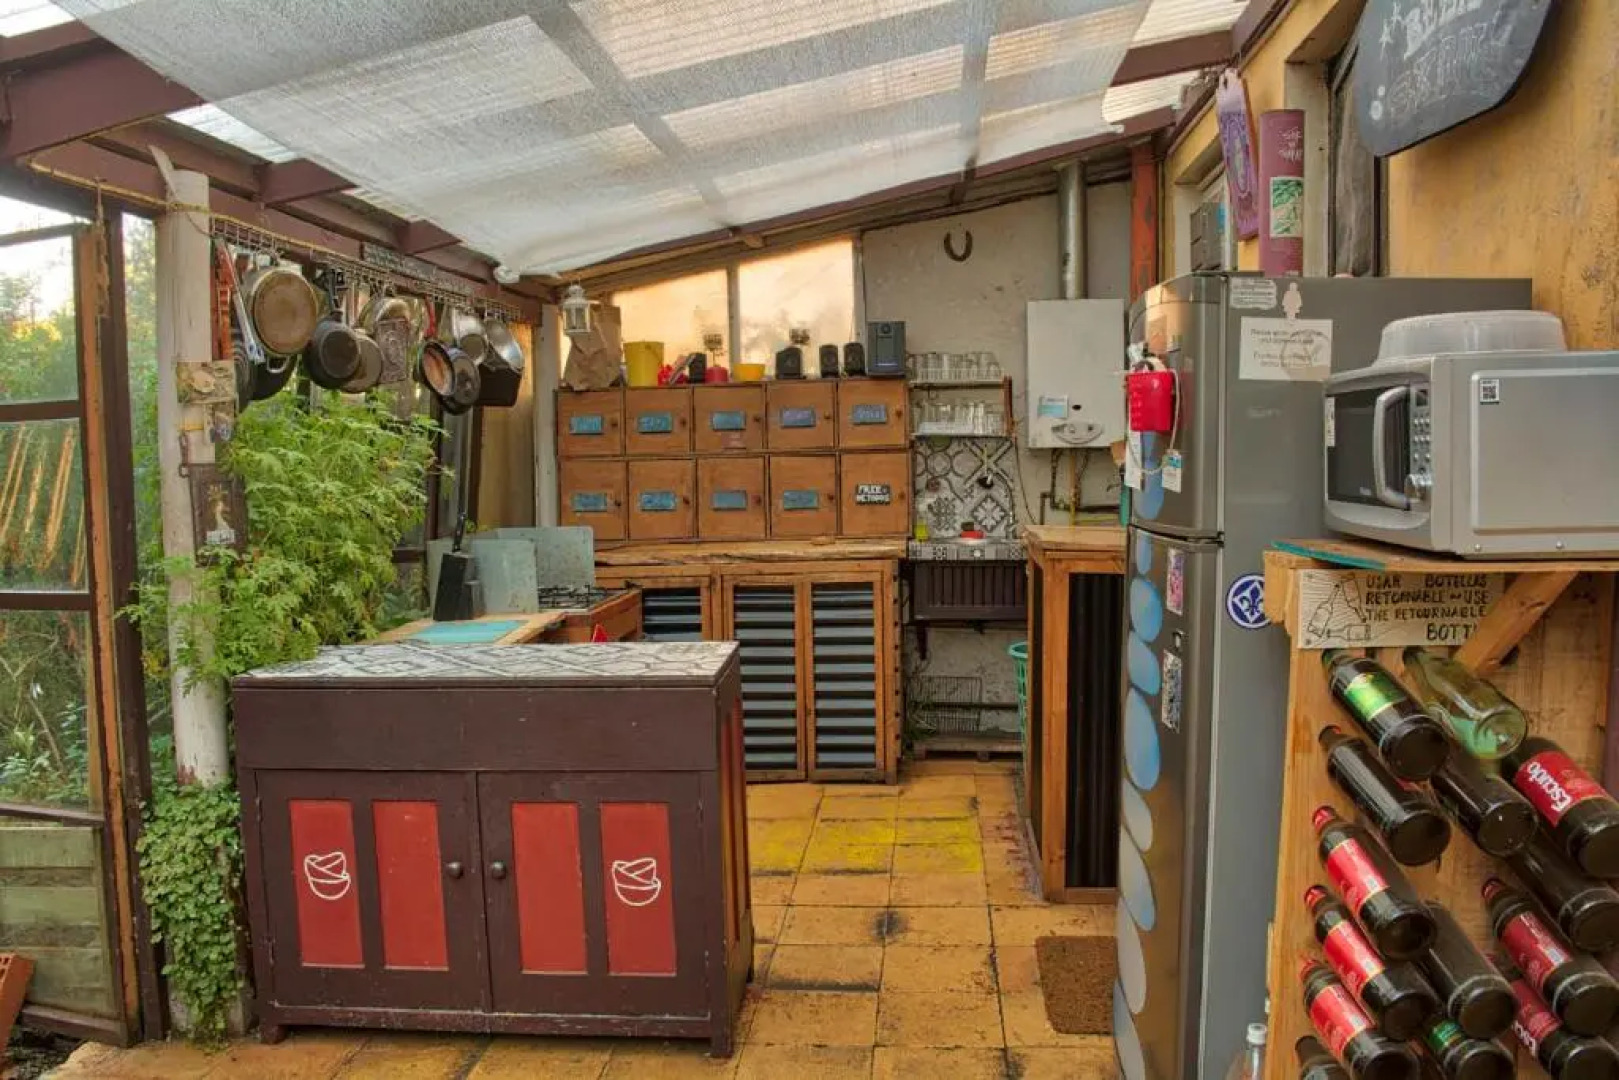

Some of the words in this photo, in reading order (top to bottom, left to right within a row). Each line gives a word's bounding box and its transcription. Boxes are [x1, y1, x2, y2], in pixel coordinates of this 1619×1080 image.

[1464, 590, 1489, 604] USE
[1366, 608, 1389, 621] THE
[1427, 622, 1477, 641] BOTT
